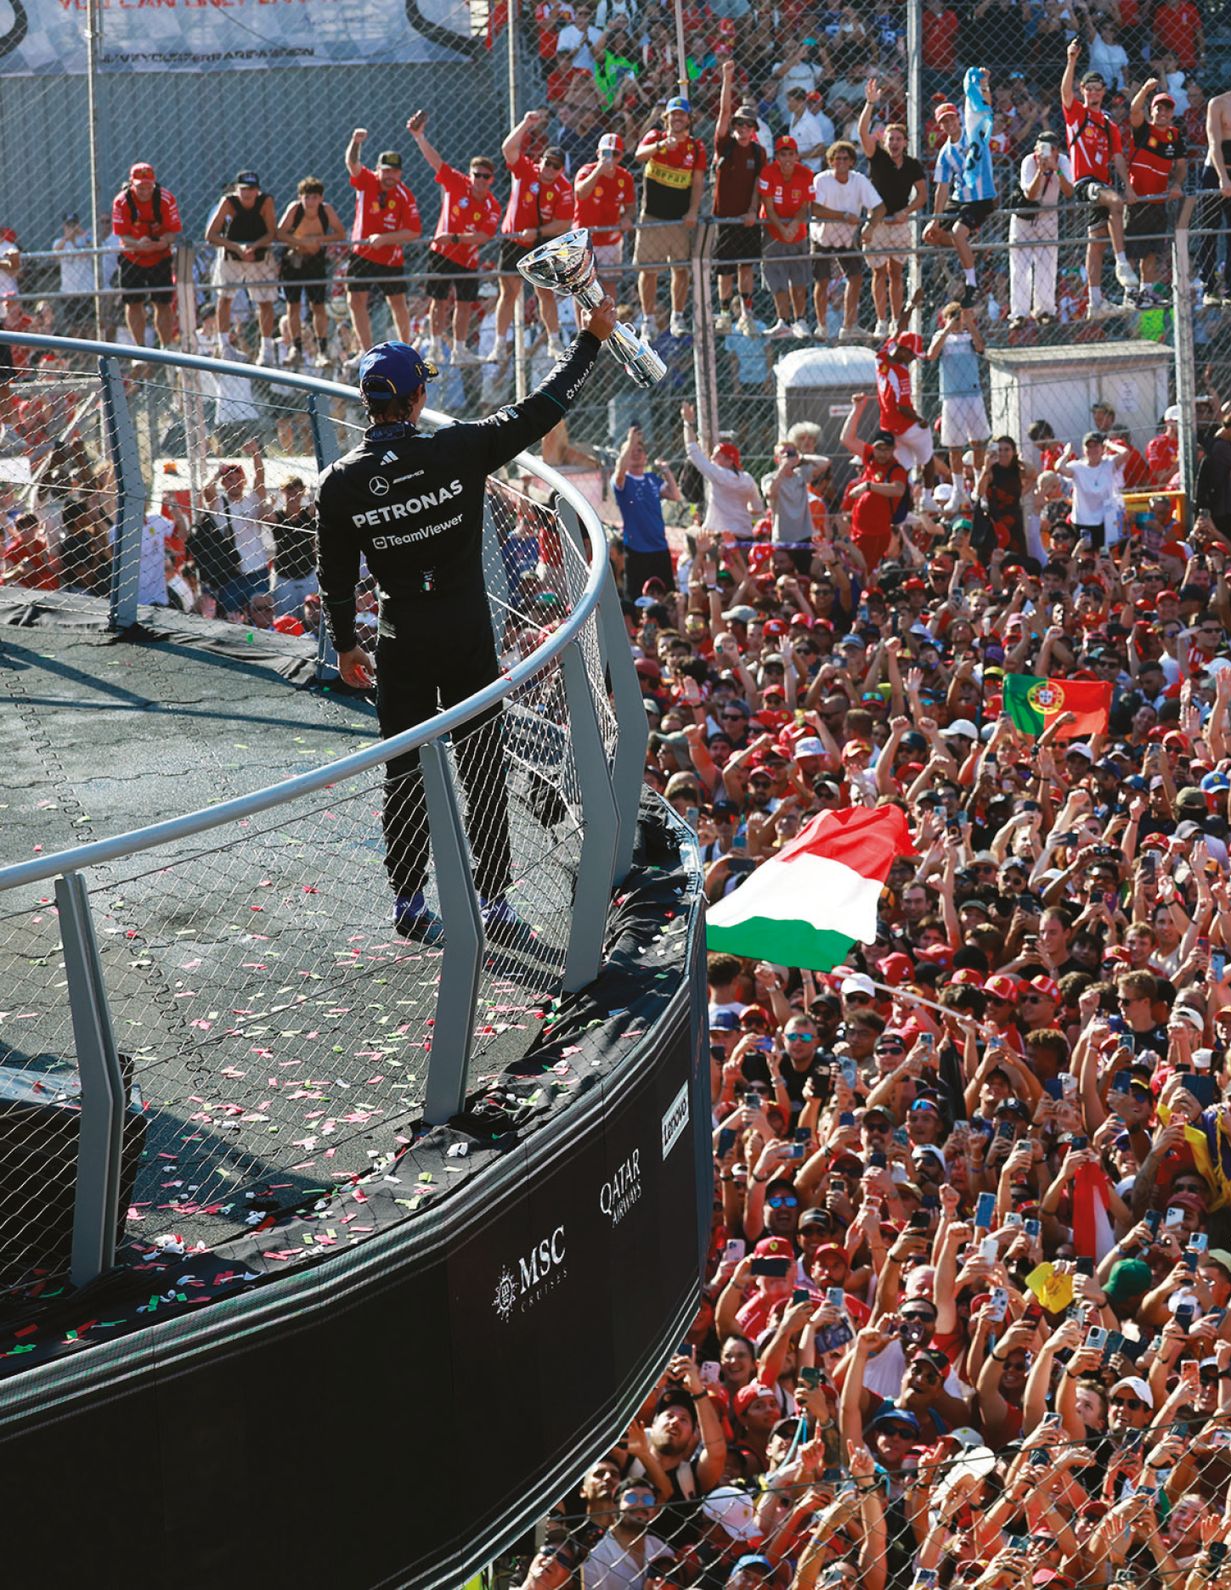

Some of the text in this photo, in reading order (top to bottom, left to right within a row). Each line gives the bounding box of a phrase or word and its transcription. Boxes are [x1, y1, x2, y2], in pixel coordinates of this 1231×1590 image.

[352, 479, 463, 528] PETRONAS
[387, 513, 463, 547] TeamViewer
[664, 1097, 687, 1146] Lenovo
[600, 1148, 641, 1215] QATAR
[612, 1179, 642, 1228] AIRWAYS
[518, 1225, 566, 1294] MSC
[520, 1268, 568, 1313] CRUISES
